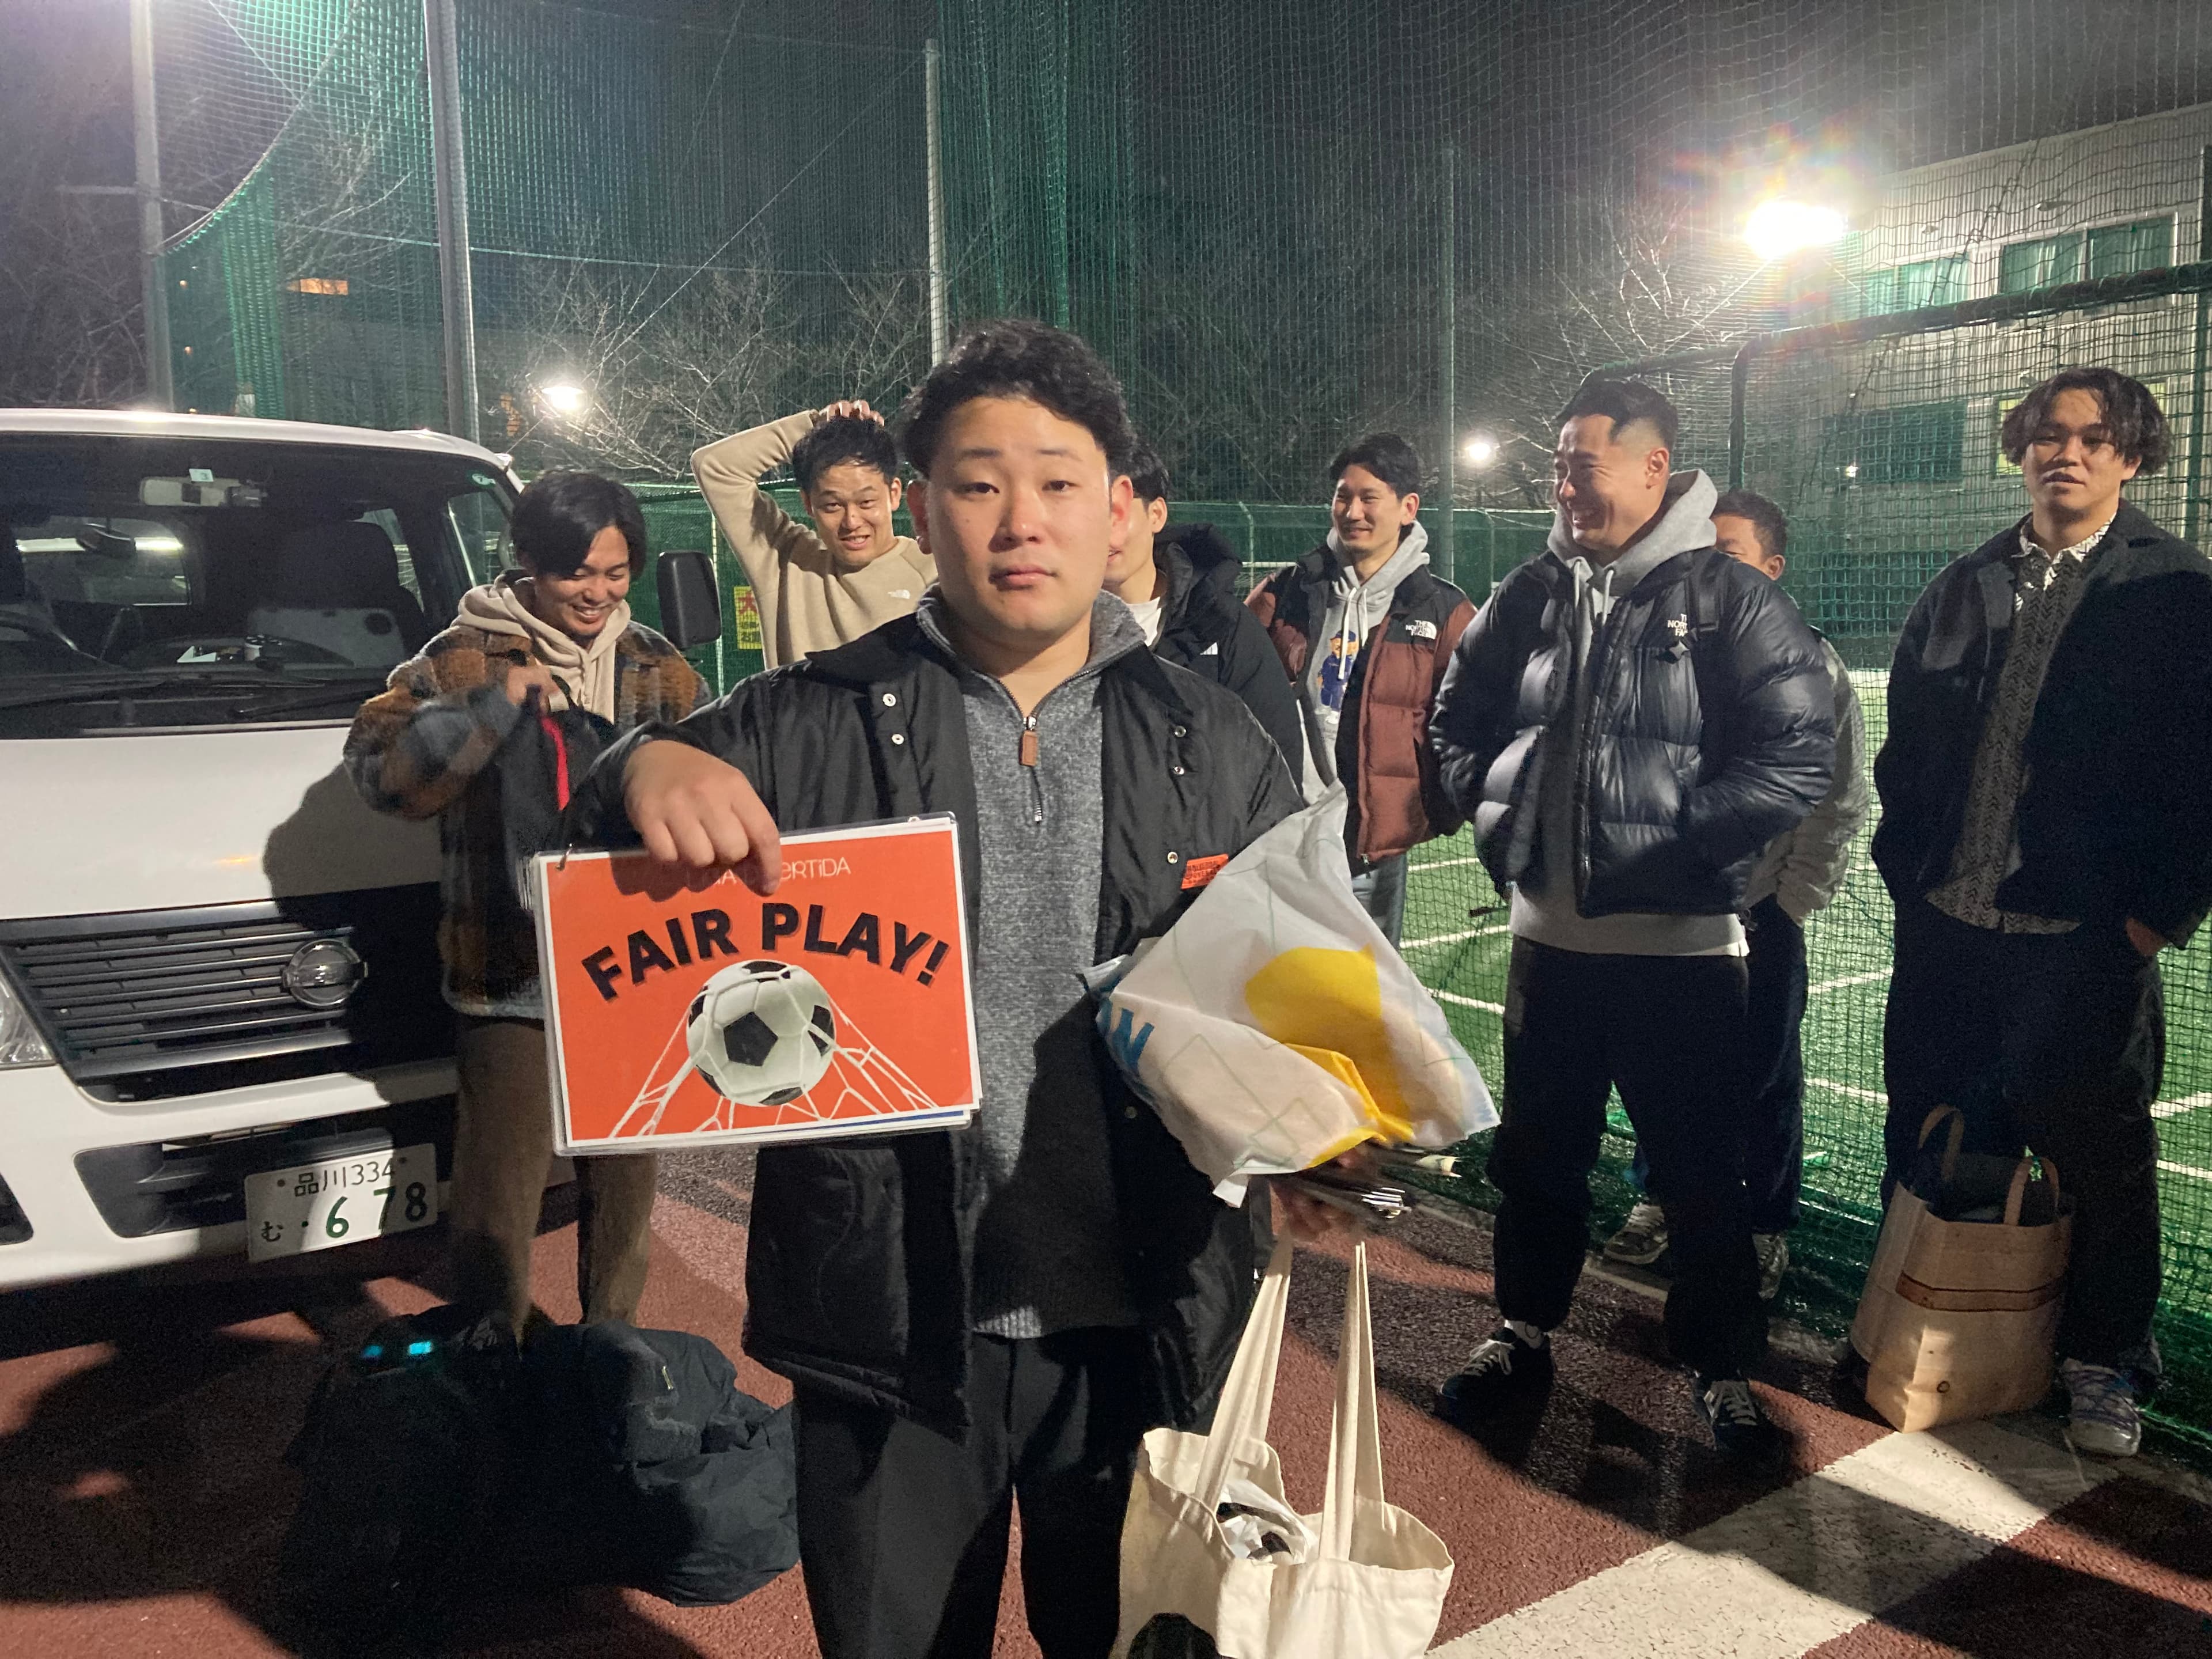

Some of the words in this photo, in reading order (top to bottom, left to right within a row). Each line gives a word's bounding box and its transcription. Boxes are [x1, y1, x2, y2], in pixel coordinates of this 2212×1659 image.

[1667, 619, 1687, 630] NORT
[581, 908, 740, 1002] FAIR
[762, 902, 950, 987] PLAY!
